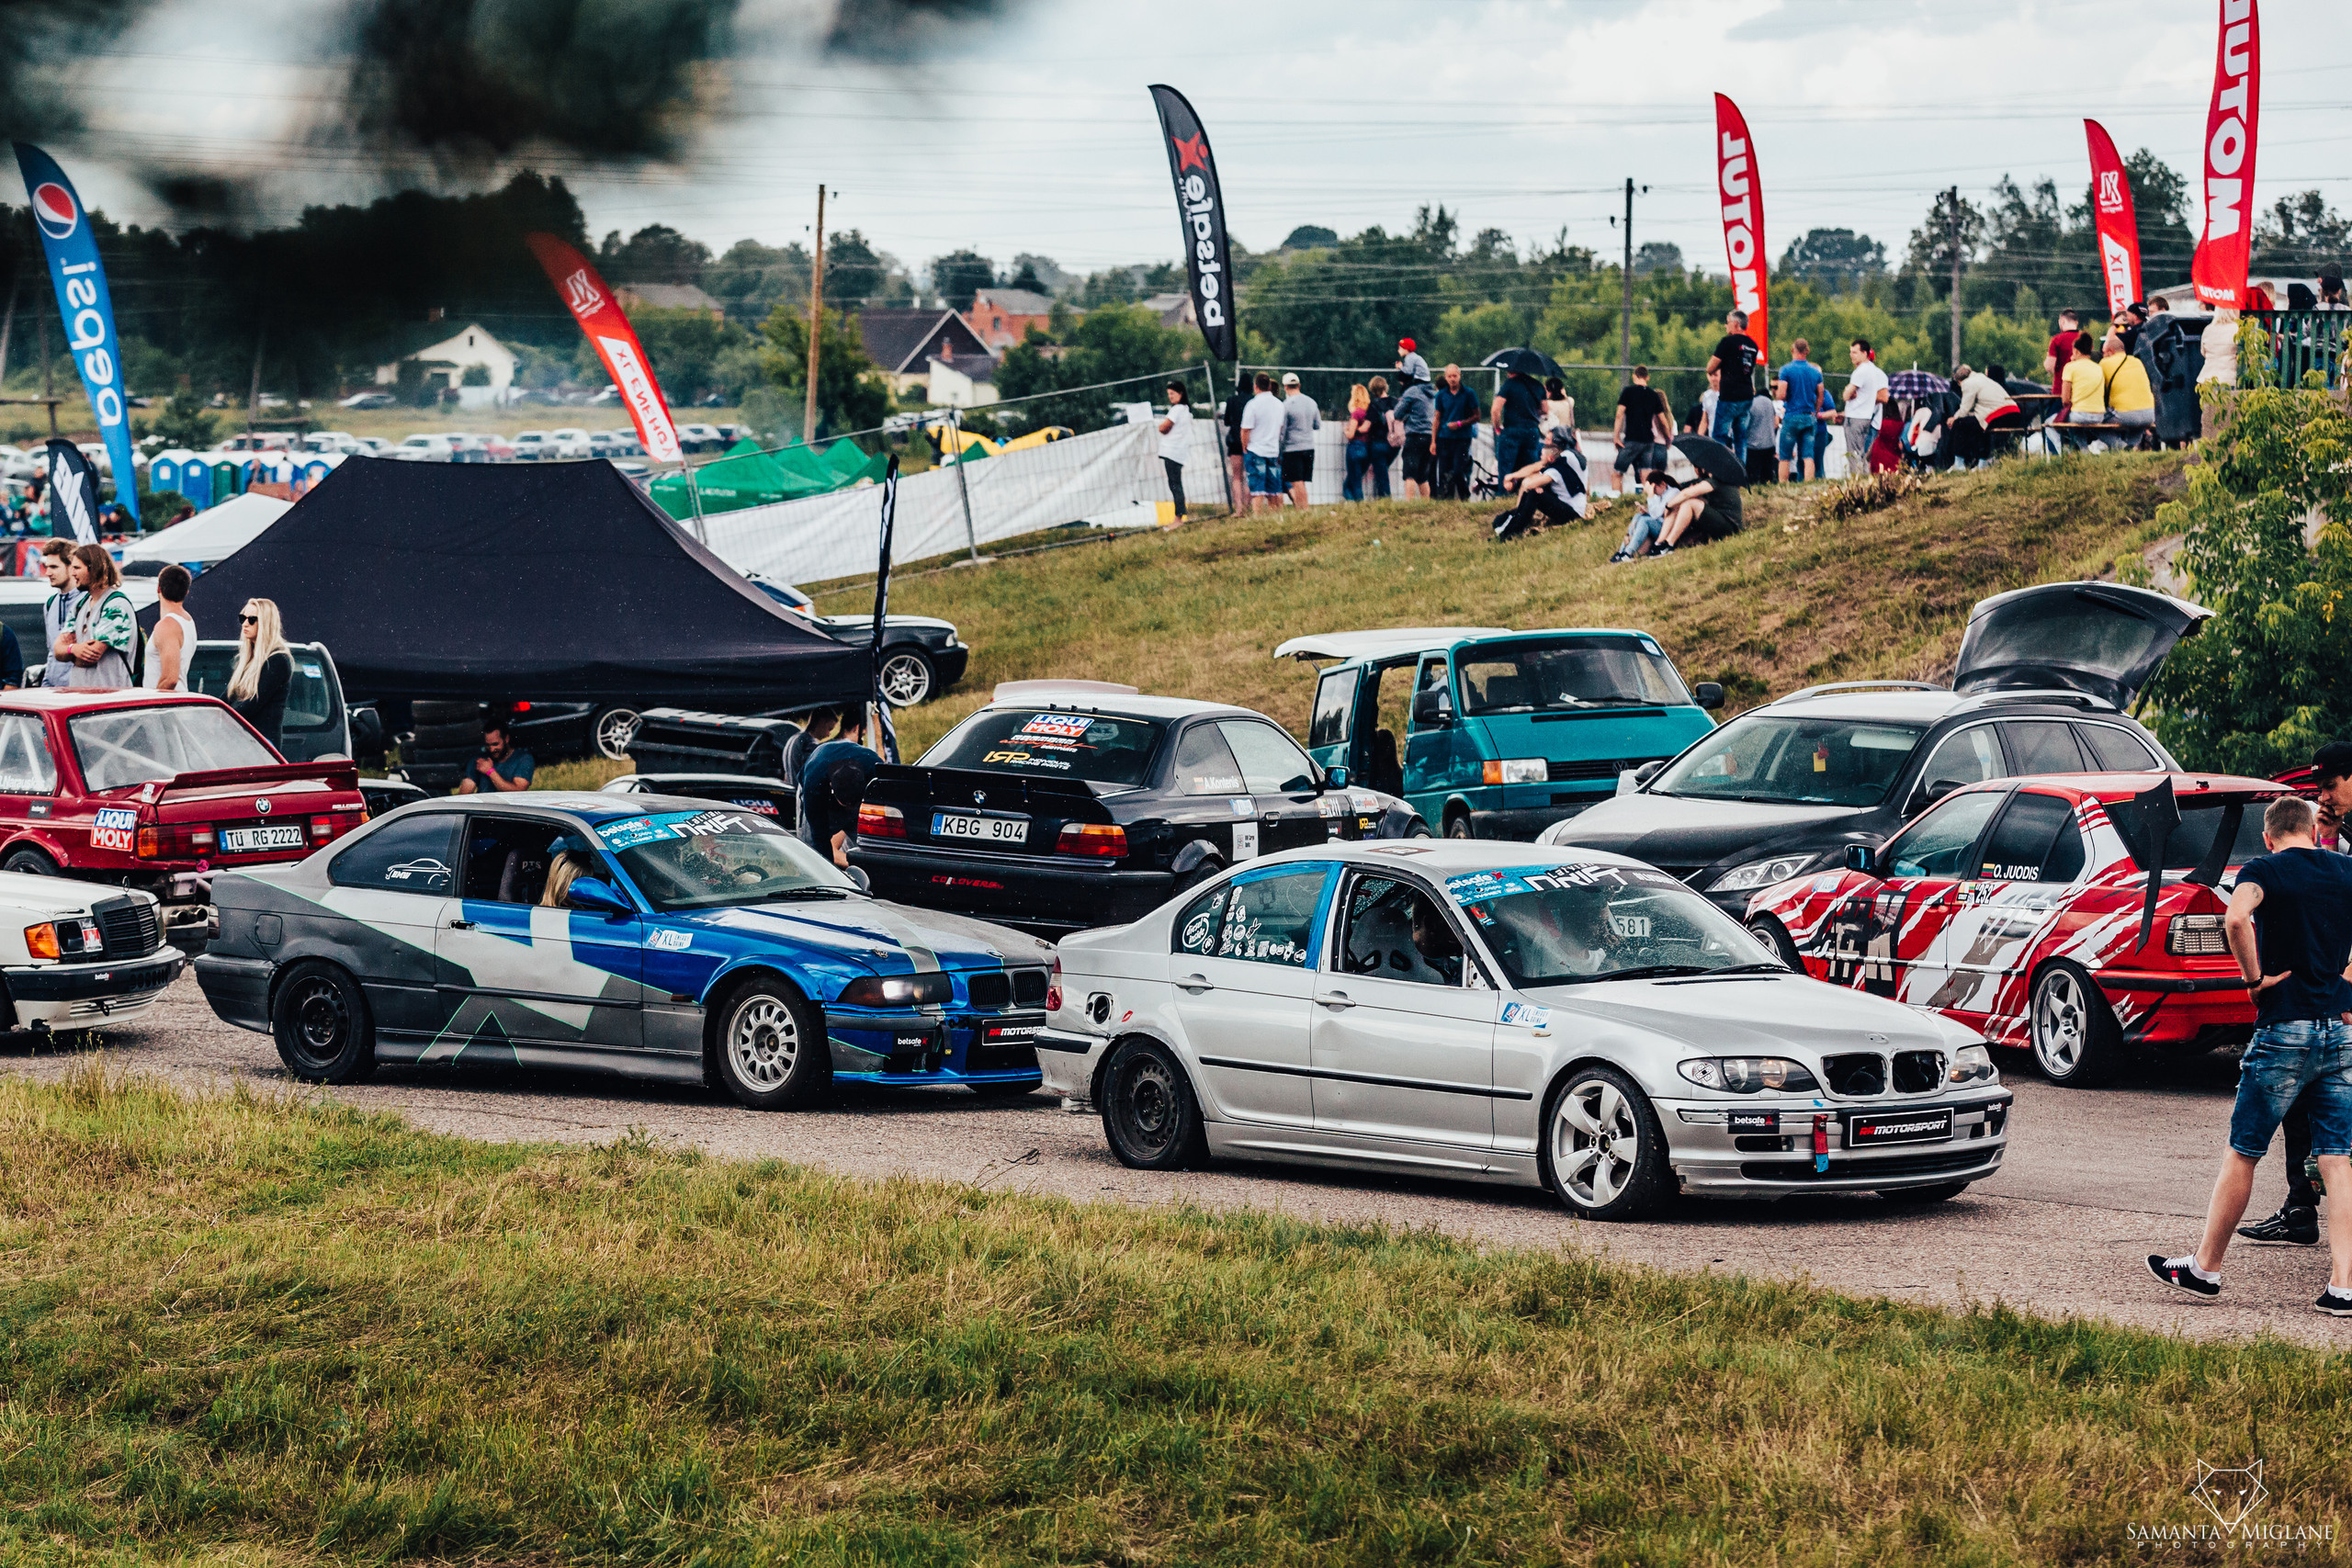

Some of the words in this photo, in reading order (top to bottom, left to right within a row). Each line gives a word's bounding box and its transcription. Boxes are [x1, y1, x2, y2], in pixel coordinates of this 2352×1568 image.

[1027, 723, 1085, 736] MOLY
[1035, 715, 1091, 727] LIQUI
[96, 810, 134, 829] LIQUI
[667, 815, 752, 838] DRIFT
[685, 810, 721, 827] Latvian
[597, 820, 644, 837] betsafe
[943, 817, 980, 836] KBG
[991, 821, 1023, 840] 904
[93, 829, 132, 849] MOLY
[227, 831, 244, 847] TÜ
[252, 829, 268, 846] RG
[270, 828, 301, 844] 2222
[392, 872, 412, 880] BMW
[1522, 865, 1629, 892] DRIFT
[1546, 862, 1595, 879] Latvian
[1993, 863, 2002, 879] O.
[2003, 864, 2040, 881] JUODIS
[662, 933, 673, 946] XL
[1518, 1008, 1531, 1021] XL
[897, 1037, 922, 1045] betsafe
[1735, 1116, 1765, 1124] betsafe
